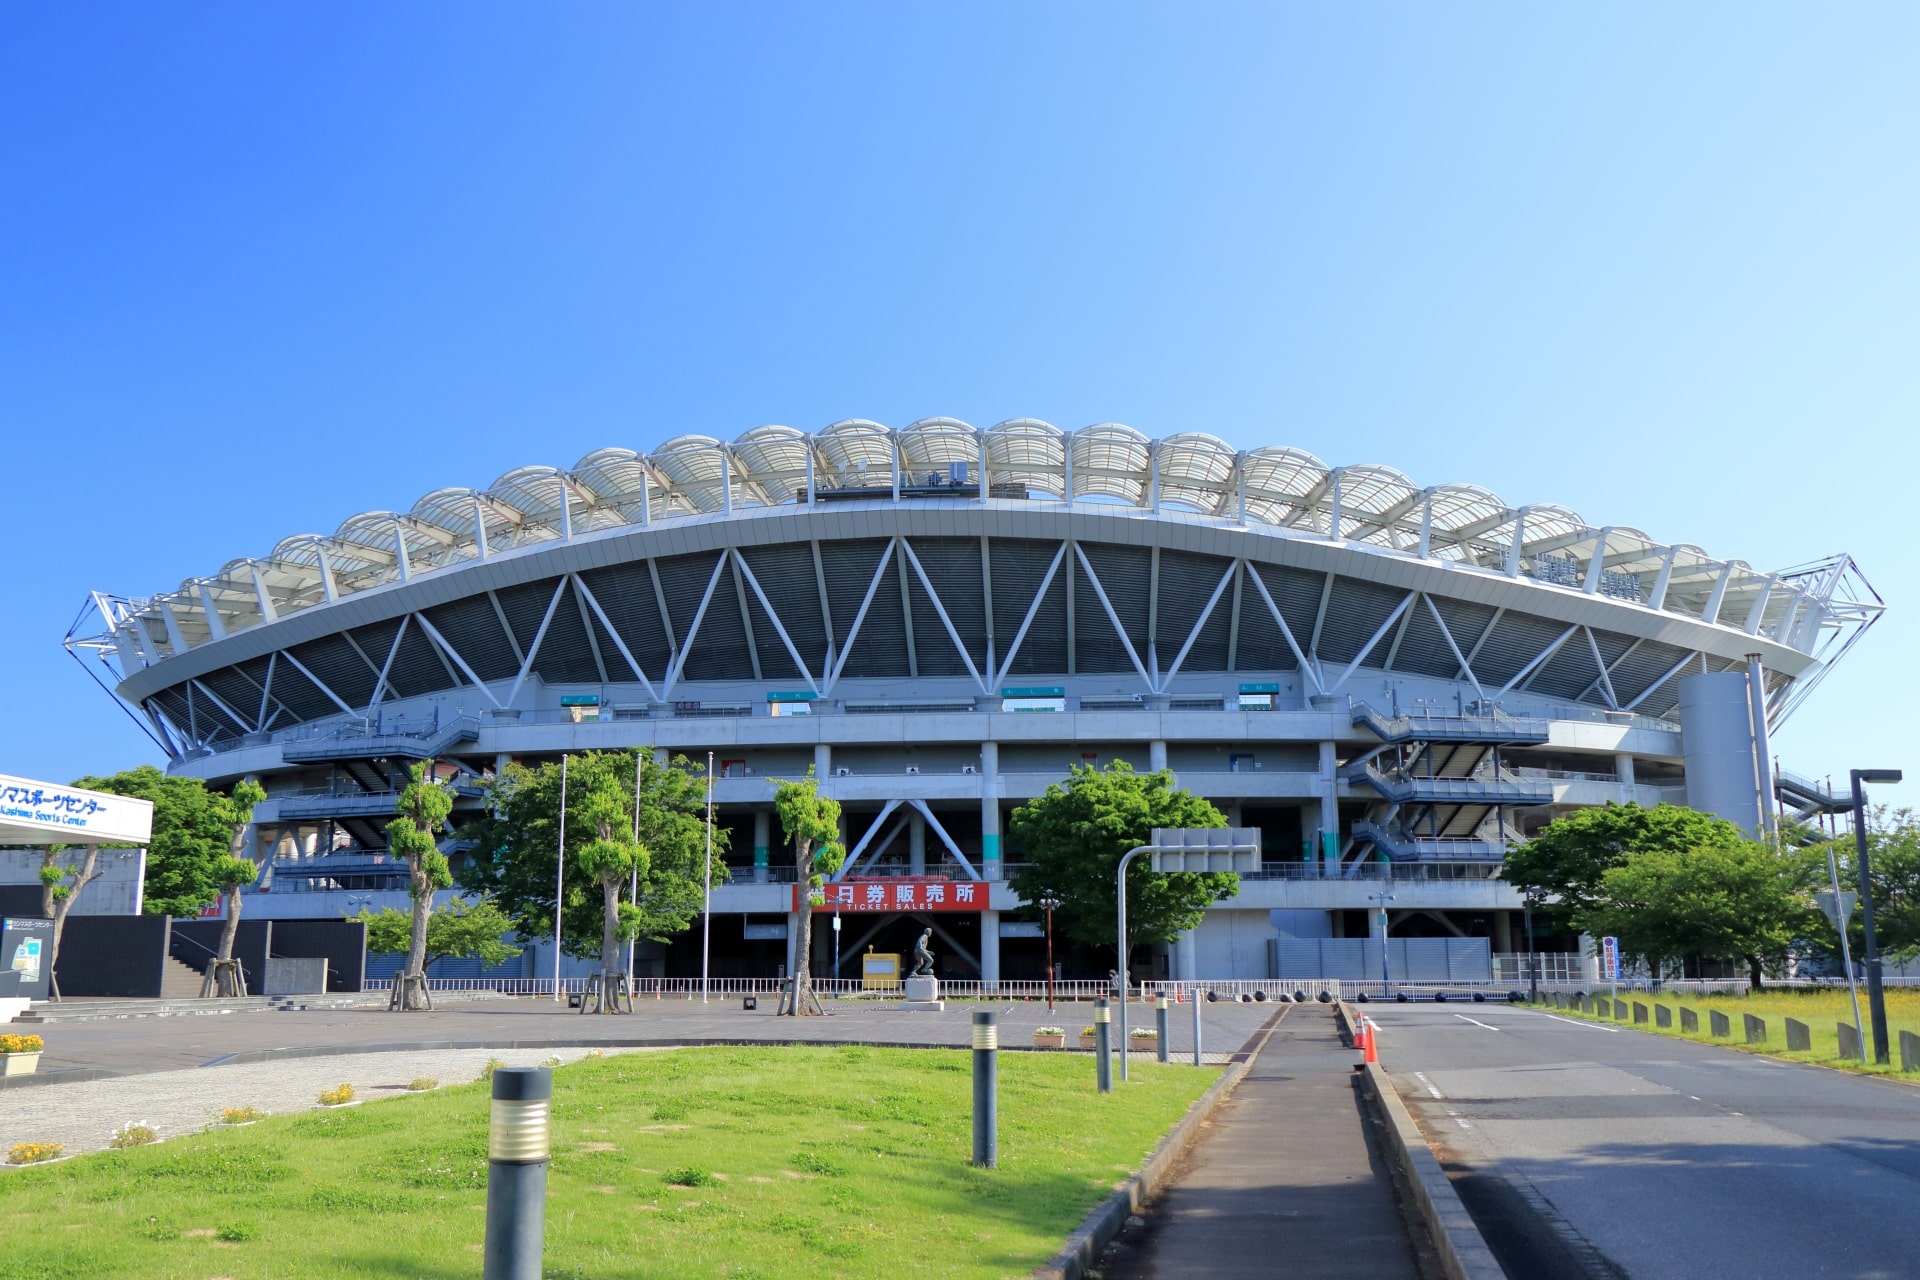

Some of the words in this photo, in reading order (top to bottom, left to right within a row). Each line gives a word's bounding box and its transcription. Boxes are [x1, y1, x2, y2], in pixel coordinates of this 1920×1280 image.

[0, 805, 33, 819] Kashima
[35, 810, 61, 823] Sports
[62, 814, 88, 826] Center
[847, 903, 889, 911] TICKET
